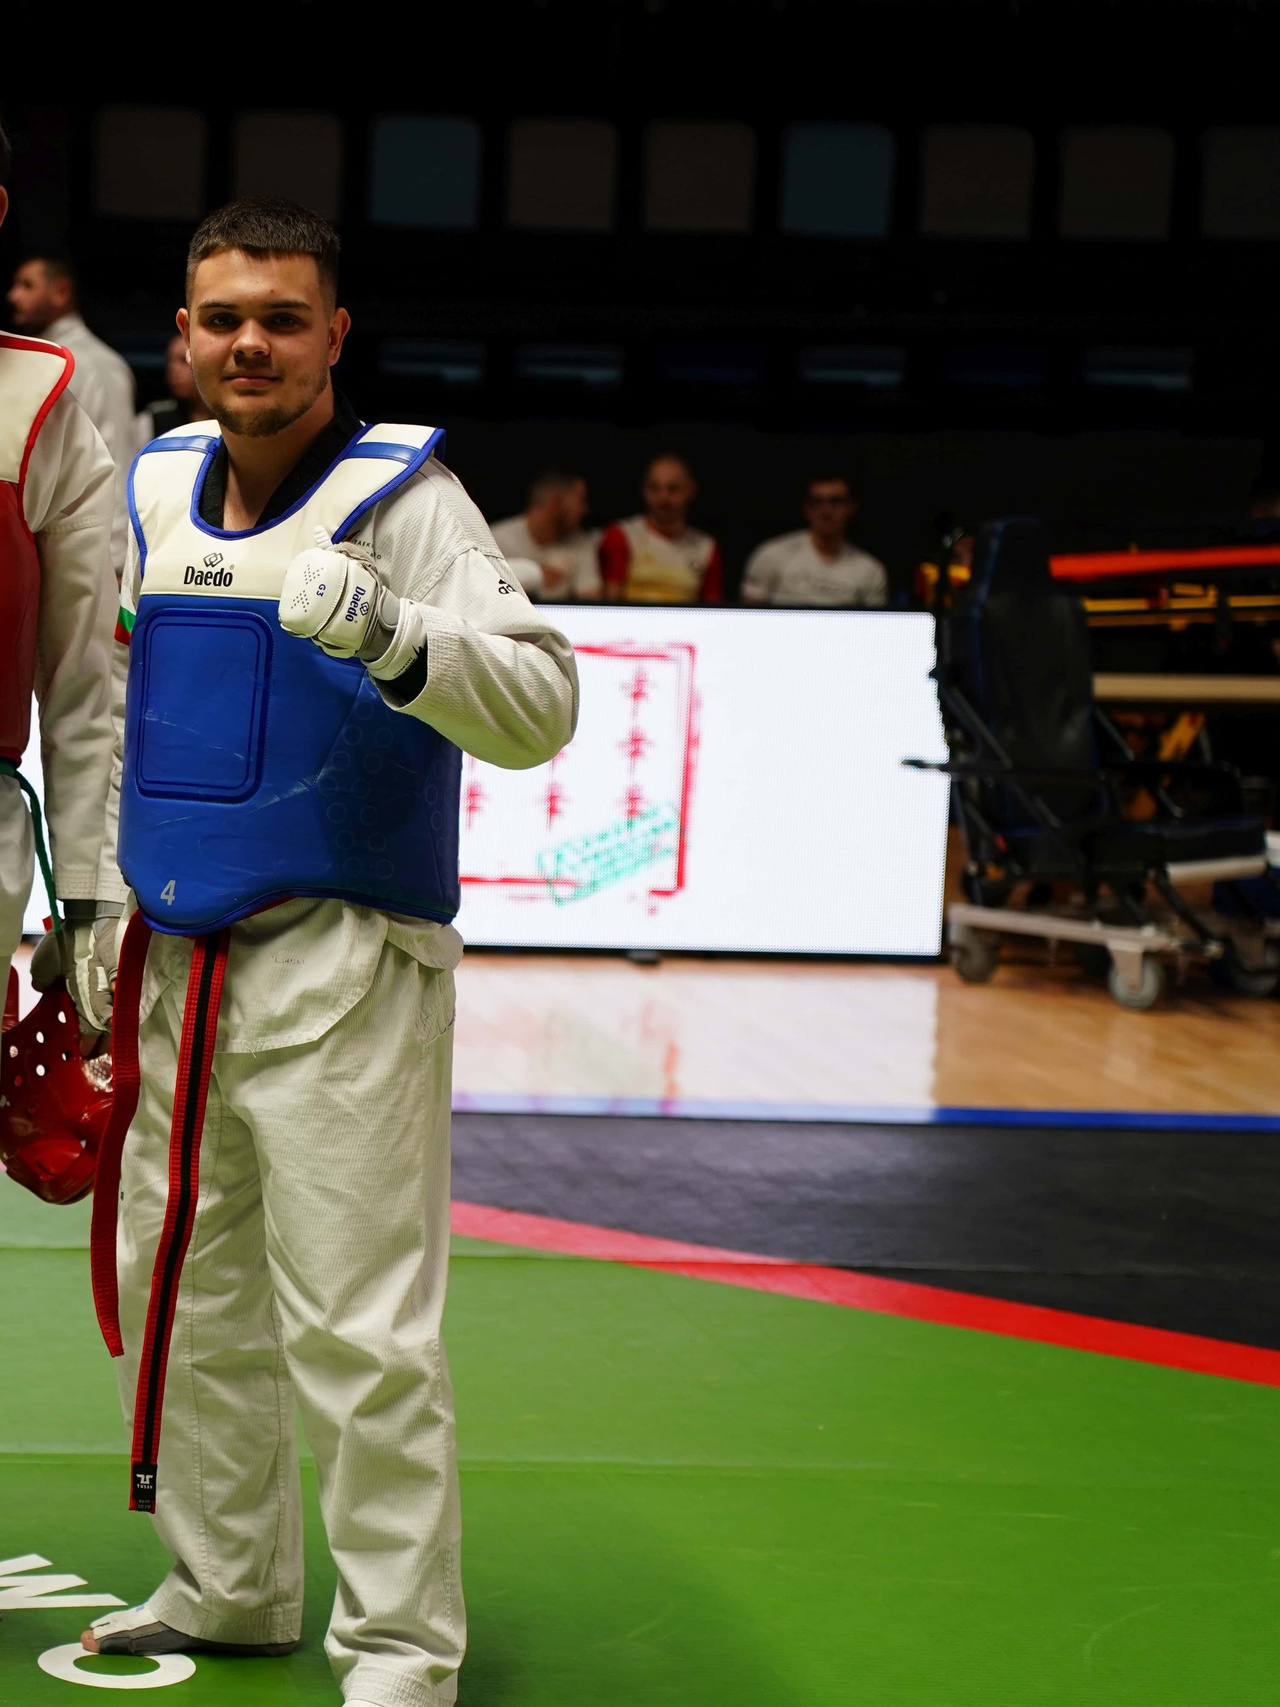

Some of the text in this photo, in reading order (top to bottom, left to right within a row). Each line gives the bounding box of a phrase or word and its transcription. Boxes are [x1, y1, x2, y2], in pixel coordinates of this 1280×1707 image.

[183, 565, 233, 587] Daedo
[316, 583, 326, 597] G3
[345, 586, 366, 622] Daedo
[160, 879, 176, 906] 4
